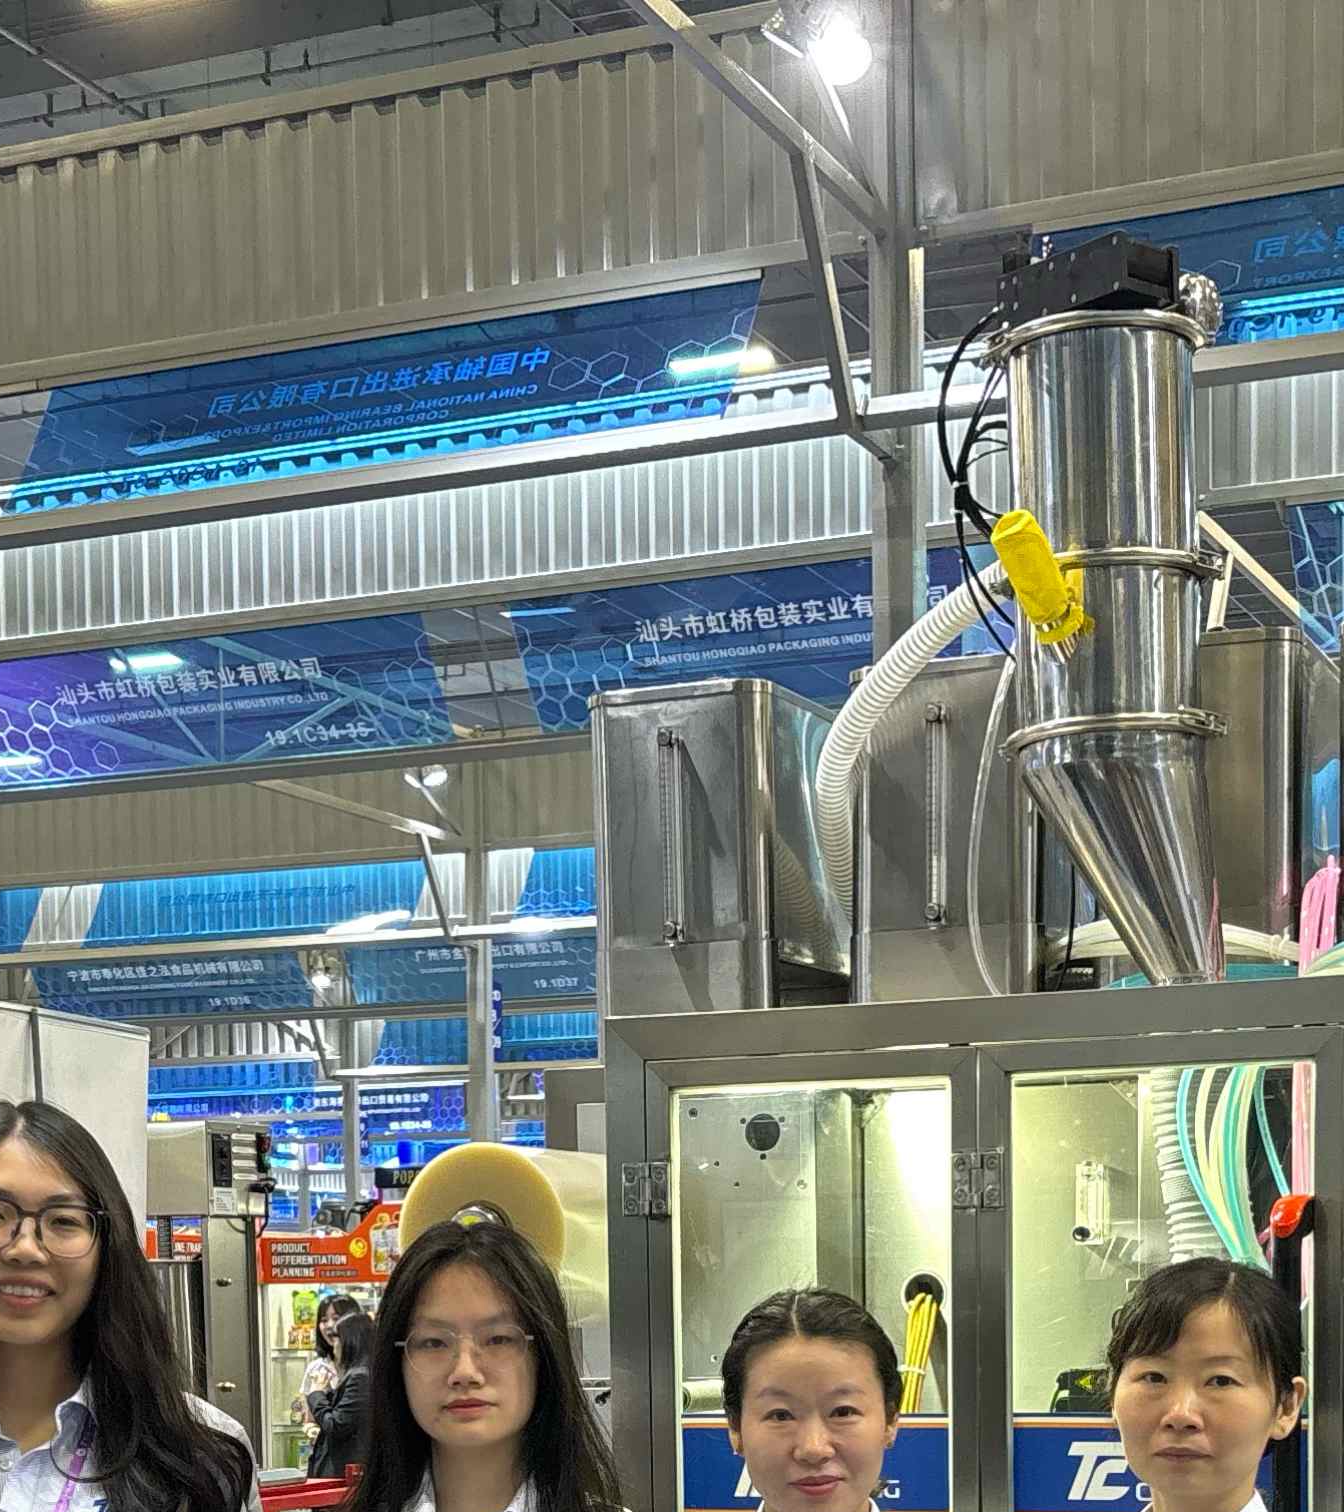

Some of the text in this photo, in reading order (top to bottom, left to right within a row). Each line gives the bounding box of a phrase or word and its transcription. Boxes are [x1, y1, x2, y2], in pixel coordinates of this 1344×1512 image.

[643, 635, 839, 667] SHANTOU HONGQIAO PACKAGING
[57, 657, 321, 706] 汕头市虹桥包装实业有限公司
[173, 703, 233, 717] PACKAGING
[235, 697, 286, 711] INDUSTRY
[271, 1243, 311, 1254] PRODUCT
[271, 1255, 347, 1266] DIFFERENTIATION
[271, 1267, 315, 1278] PLANNING
